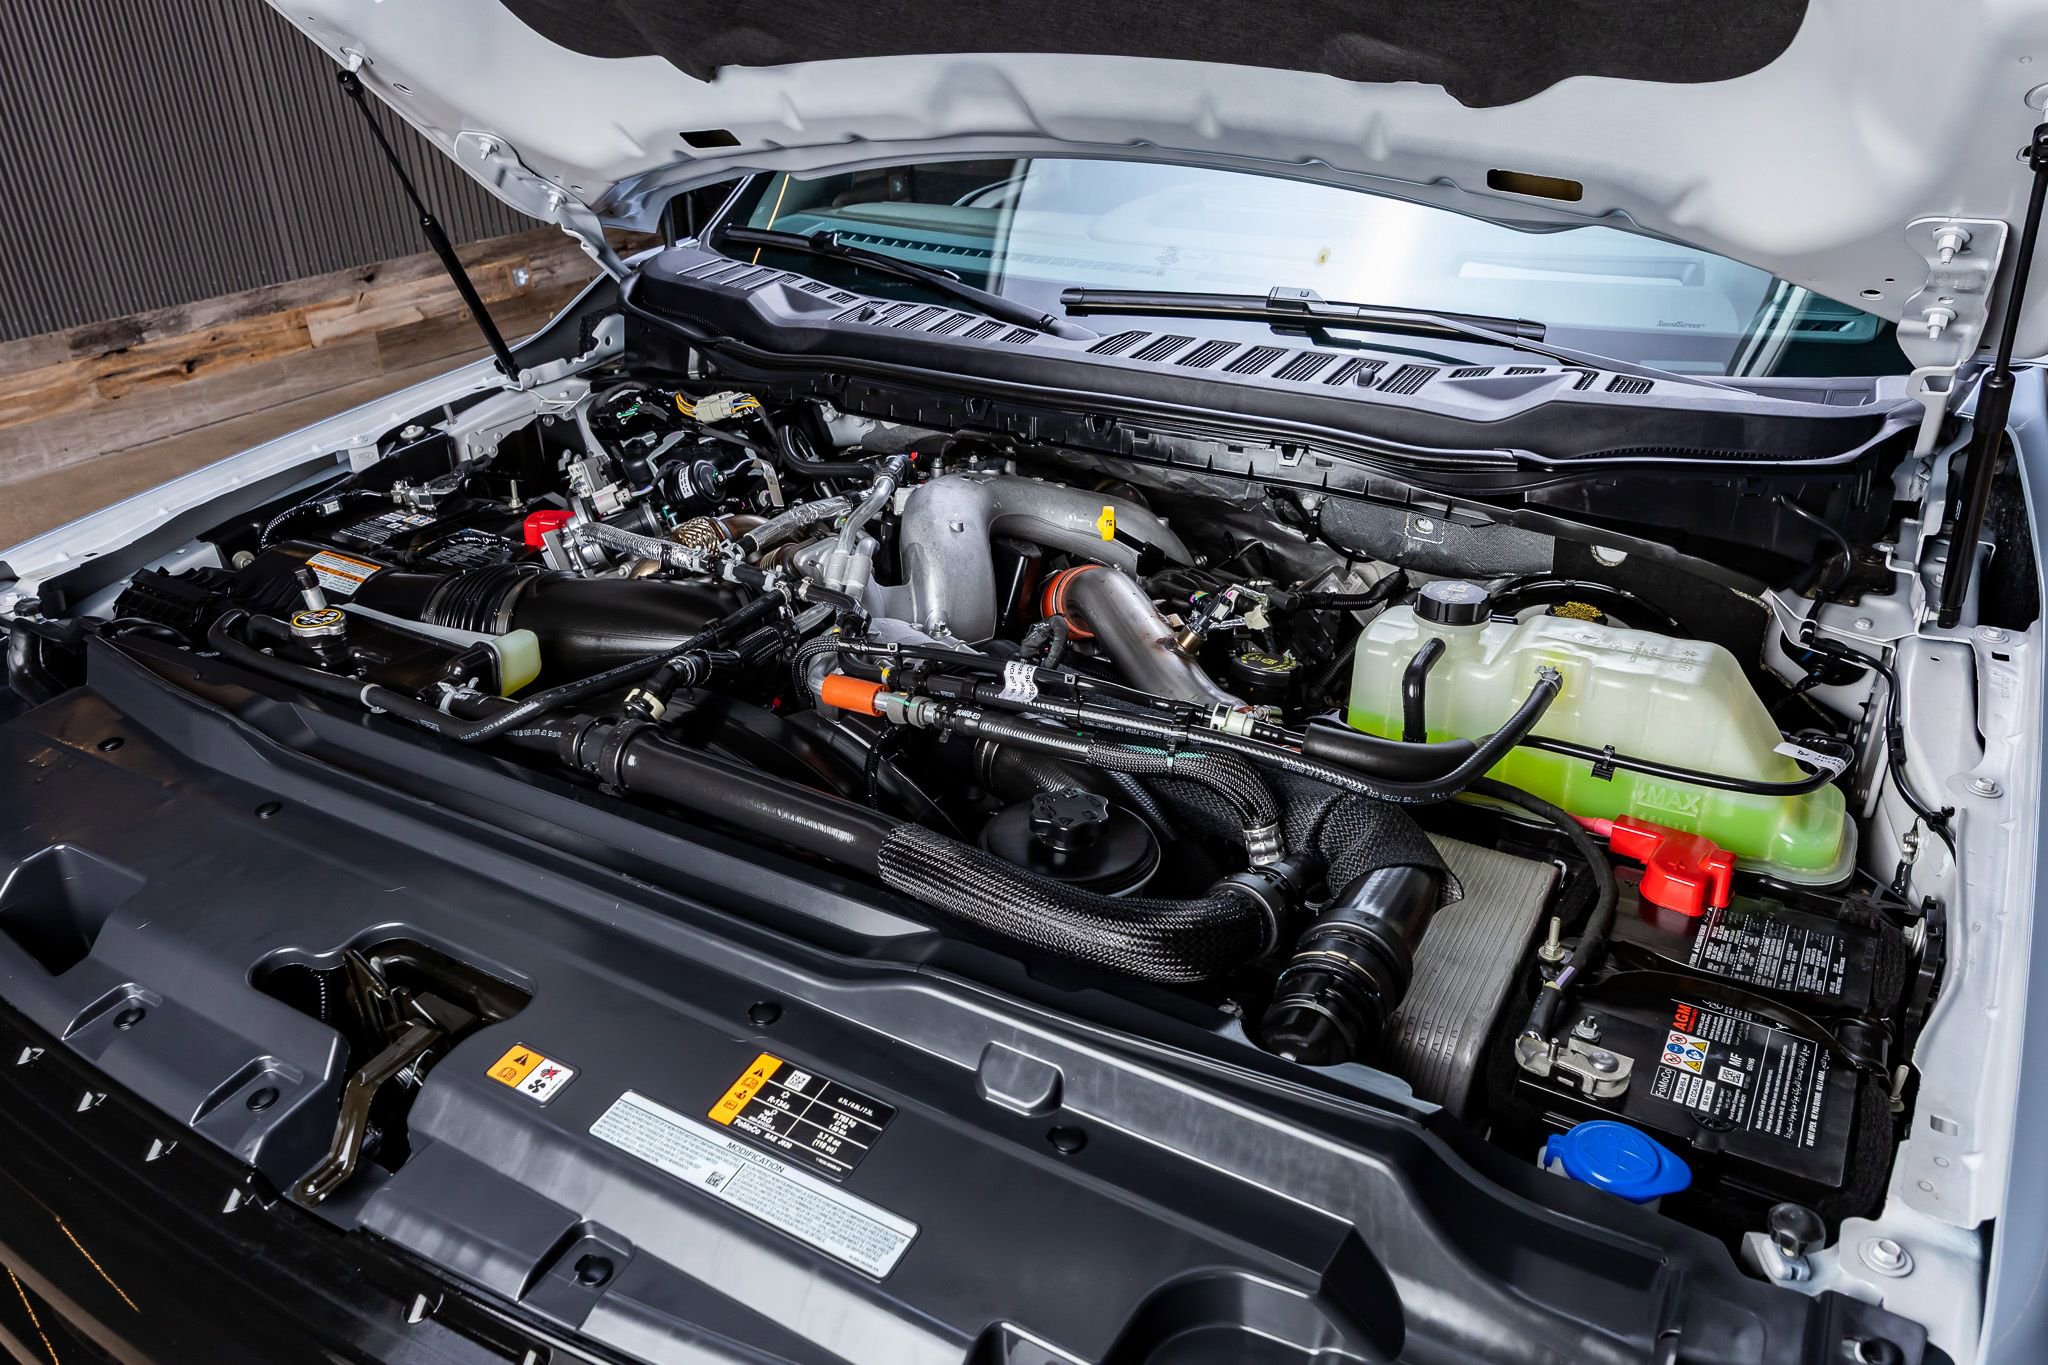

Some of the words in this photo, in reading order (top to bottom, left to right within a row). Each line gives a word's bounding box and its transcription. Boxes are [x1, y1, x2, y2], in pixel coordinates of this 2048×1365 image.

[1647, 788, 1701, 811] MAX
[1671, 1003, 1691, 1030] AGM
[1728, 1051, 1742, 1067] MF
[1655, 1067, 1671, 1097] FoMoCo
[765, 1094, 792, 1110] R-134a
[732, 1117, 762, 1135] FoMoCo
[756, 1112, 774, 1124] PAG
[725, 1141, 786, 1173] MODIFICATION
